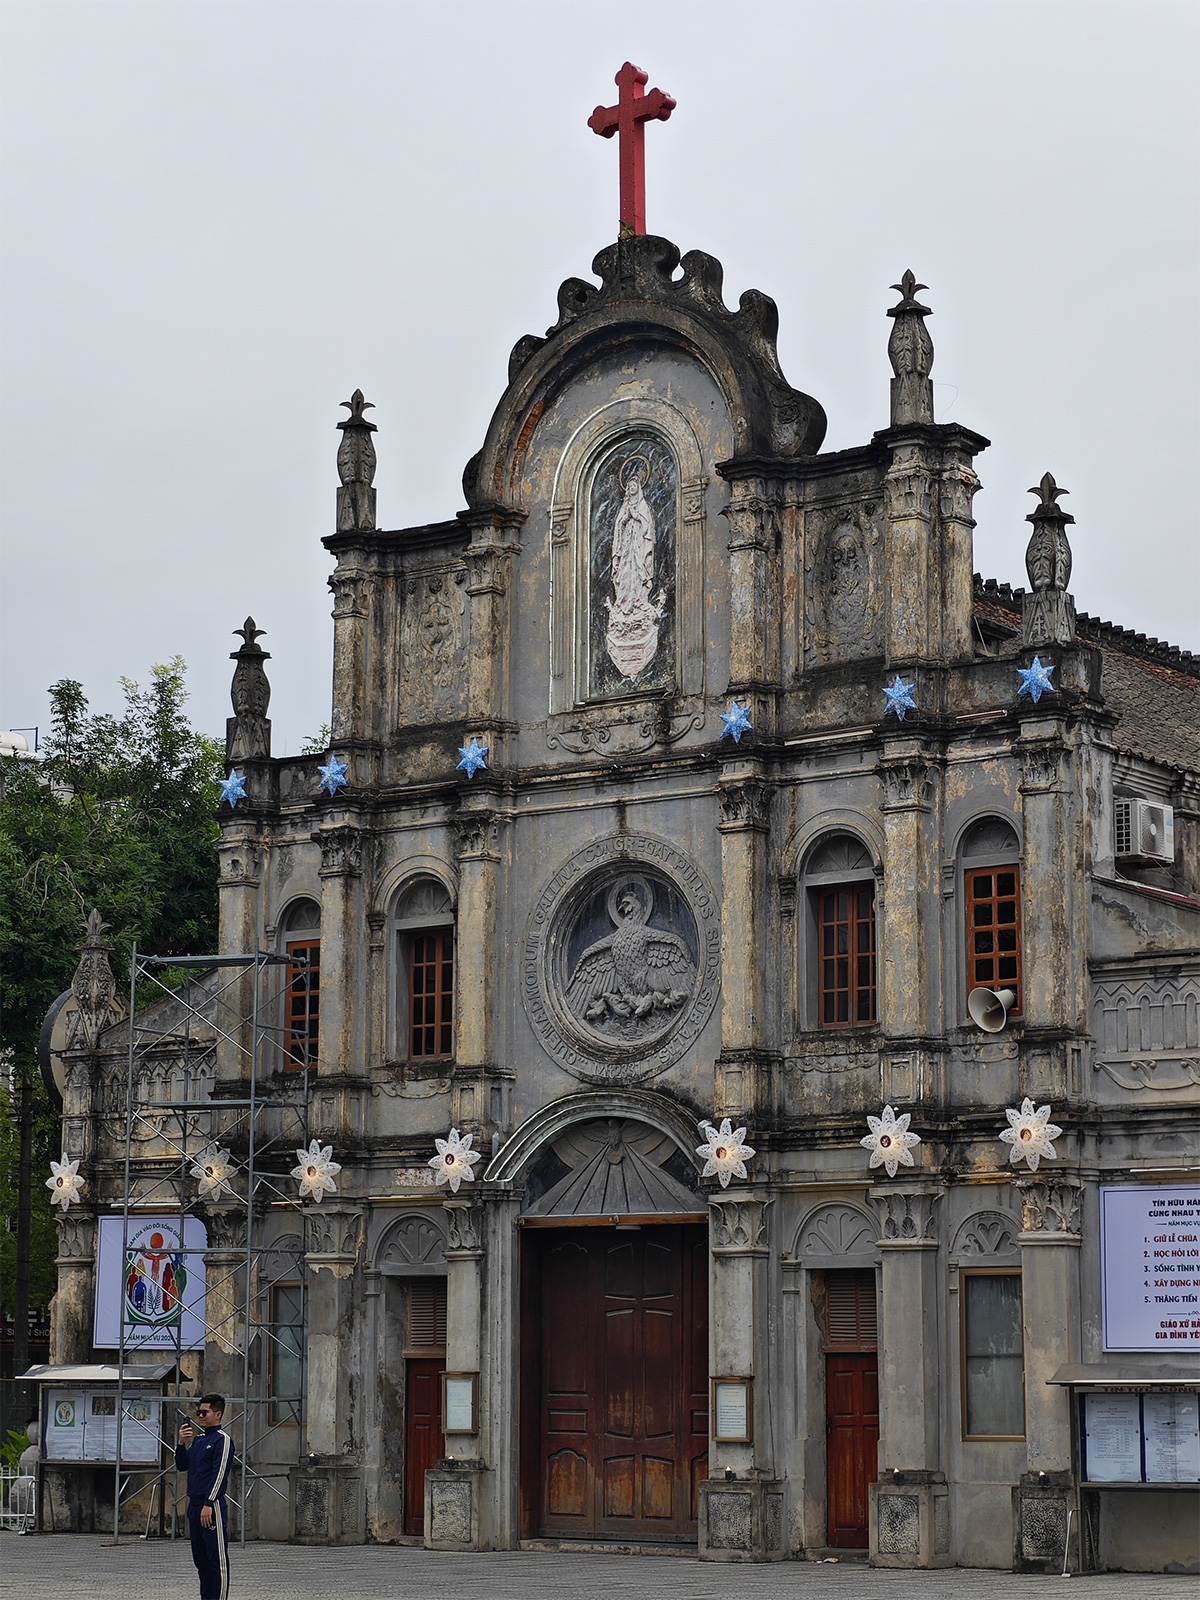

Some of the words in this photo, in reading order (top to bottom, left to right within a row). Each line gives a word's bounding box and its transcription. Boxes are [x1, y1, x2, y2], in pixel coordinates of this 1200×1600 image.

[584, 837, 675, 863] CONGREGAT
[534, 862, 581, 924] GALLINA
[674, 858, 714, 920] PULLOS
[705, 926, 720, 981] SUOS
[689, 985, 713, 1026] SUB
[1152, 1199, 1166, 1207] TÍN
[1148, 1209, 1169, 1217] CÙNG
[1177, 1234, 1198, 1242] CHÚA
[1153, 1250, 1170, 1258] HỌC
[1187, 1248, 1199, 1257] LỜI
[1154, 1263, 1175, 1273] SỐNG
[1177, 1263, 1195, 1272] TÌNH
[1154, 1278, 1168, 1287] XÂY
[1170, 1279, 1191, 1288] DỰNG
[1181, 1293, 1198, 1303] TIẾN
[1160, 1318, 1177, 1328] GIÁO
[1179, 1319, 1190, 1328] XỨ
[1170, 1330, 1188, 1339] ĐÌNH
